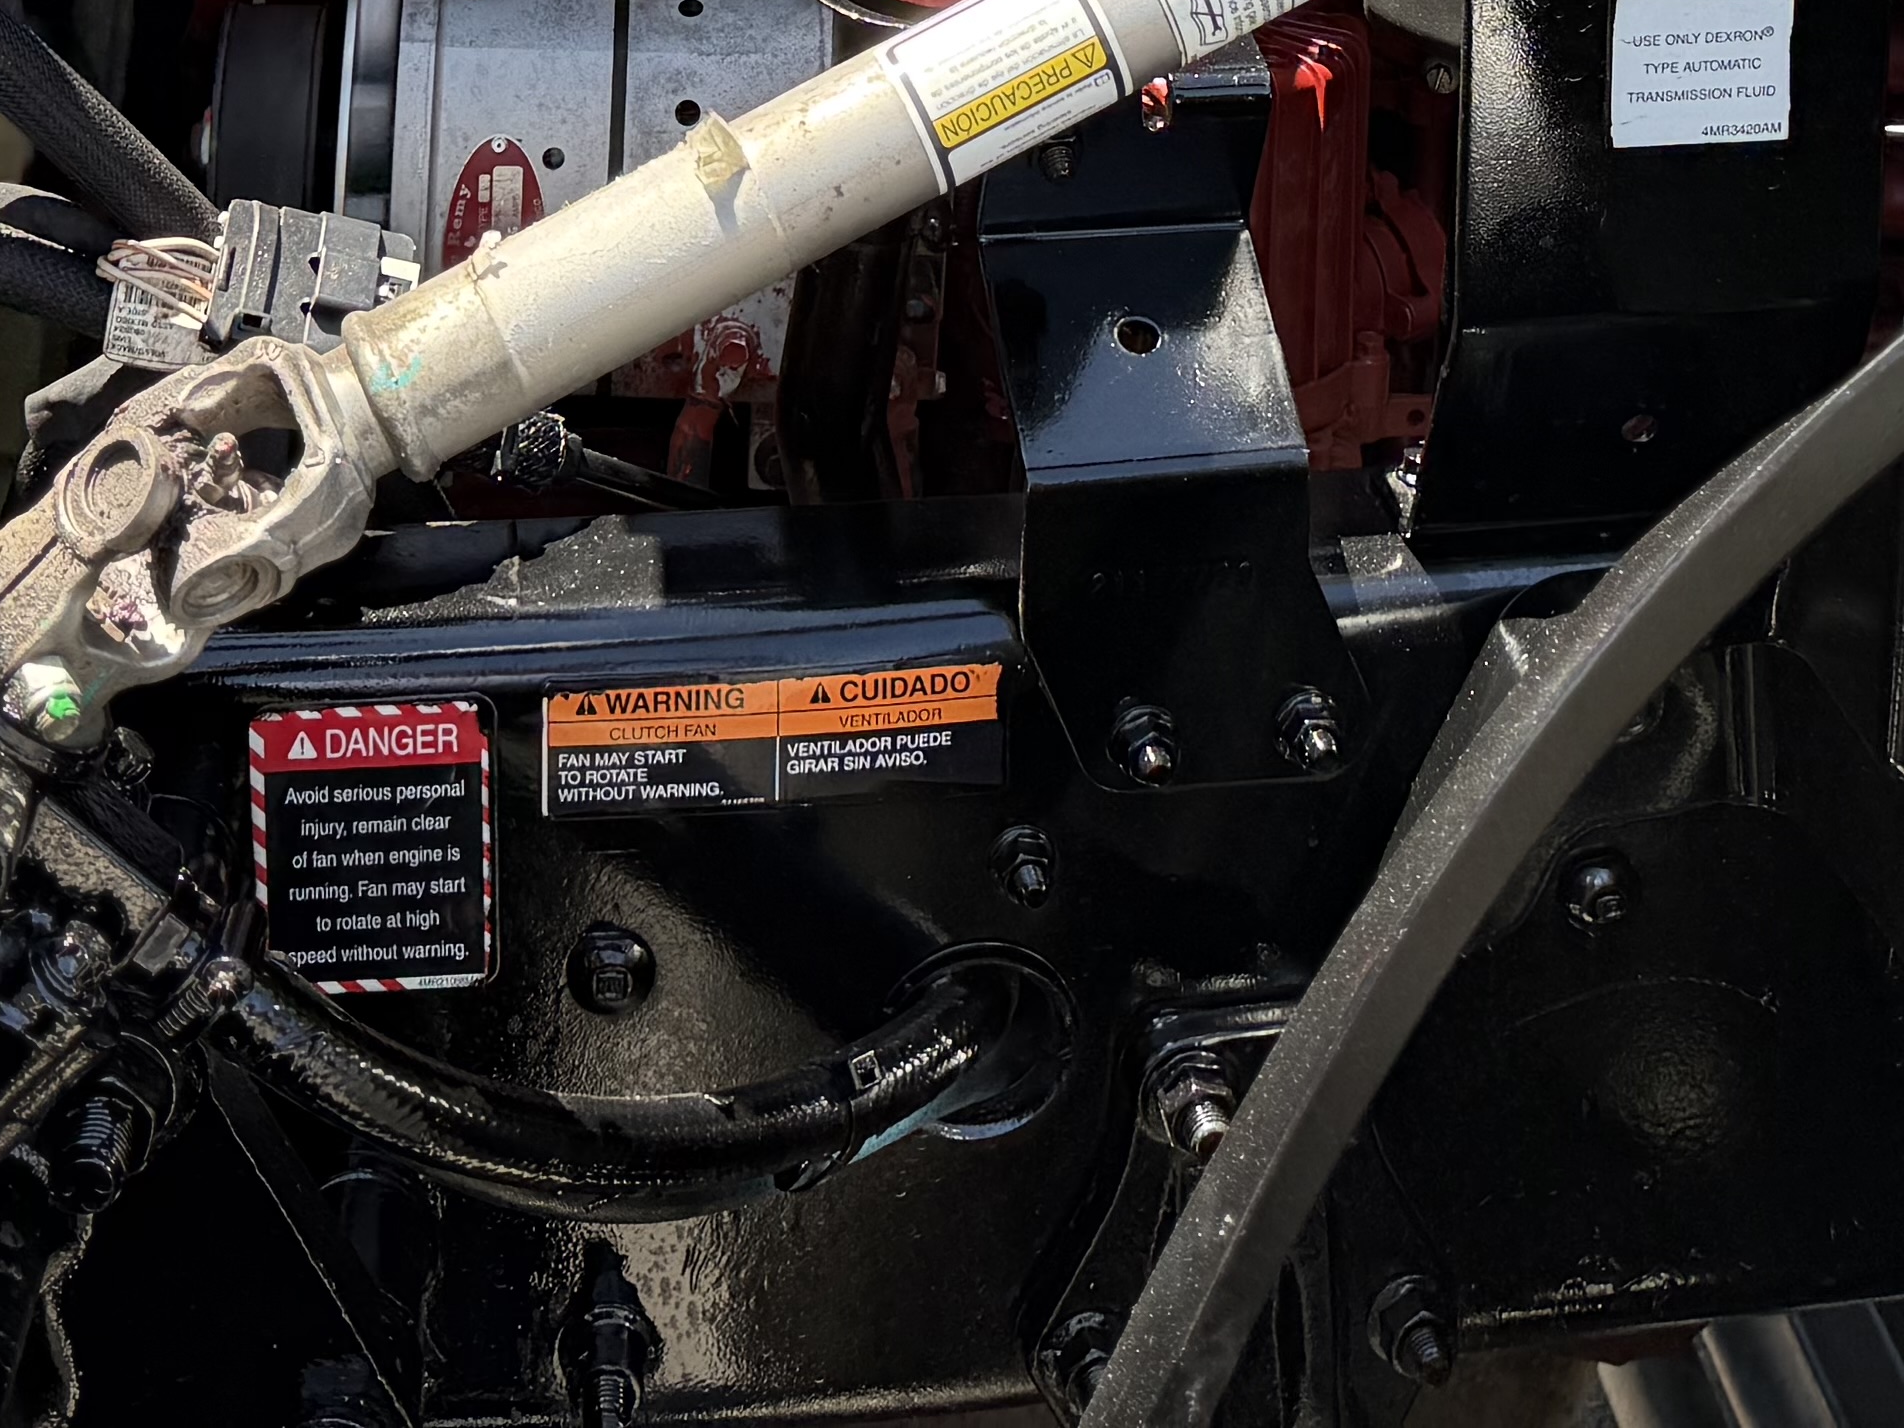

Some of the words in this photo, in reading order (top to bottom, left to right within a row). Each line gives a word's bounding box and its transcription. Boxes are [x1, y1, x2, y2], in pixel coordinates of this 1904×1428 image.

[1633, 34, 1661, 48] USE
[1665, 32, 1701, 46] ONLY
[1643, 61, 1679, 75] TYPE
[1683, 57, 1762, 73] AUTOMATIC
[940, 63, 1075, 143] PRECAUCIÓN
[1627, 87, 1732, 104] TRANSMISSION
[1736, 85, 1776, 99] FLUID
[447, 184, 472, 248] Remy
[839, 670, 971, 703] CUIDADO
[604, 688, 745, 715] WARNING
[839, 707, 942, 728] VENTILADOR
[325, 723, 459, 759] DANGER
[609, 725, 679, 741] CLUTCH
[684, 723, 717, 737] FAN
[787, 736, 891, 758] VENTILADOR
[896, 731, 952, 748] PUEDE
[558, 752, 591, 768] FAN
[595, 751, 630, 767] MAY
[634, 749, 687, 765] START
[786, 757, 839, 775] GIRAR
[843, 755, 871, 771] SIN
[874, 751, 928, 769] AVISO.
[558, 771, 580, 785] TO
[585, 768, 648, 784] ROTATE
[284, 785, 329, 805] Avoid
[333, 784, 392, 803] serious
[396, 780, 466, 804] personal
[557, 786, 636, 803] WITHOUT
[640, 782, 724, 800] WARNING.
[301, 819, 347, 840] injury,
[353, 816, 407, 834] remain
[412, 814, 452, 831] clear
[292, 851, 307, 869] of
[312, 850, 336, 868] fan
[342, 848, 384, 866] when
[389, 846, 443, 868] engine
[447, 844, 461, 861] is
[289, 883, 353, 903] running.
[358, 881, 388, 897] Fan
[392, 881, 426, 899] may
[430, 877, 466, 893] start
[316, 916, 332, 932] to
[336, 913, 382, 931] rotate
[387, 913, 401, 928] at
[407, 909, 440, 931] high
[287, 945, 337, 968] speed
[341, 943, 398, 963] without
[402, 941, 469, 961] warning.
